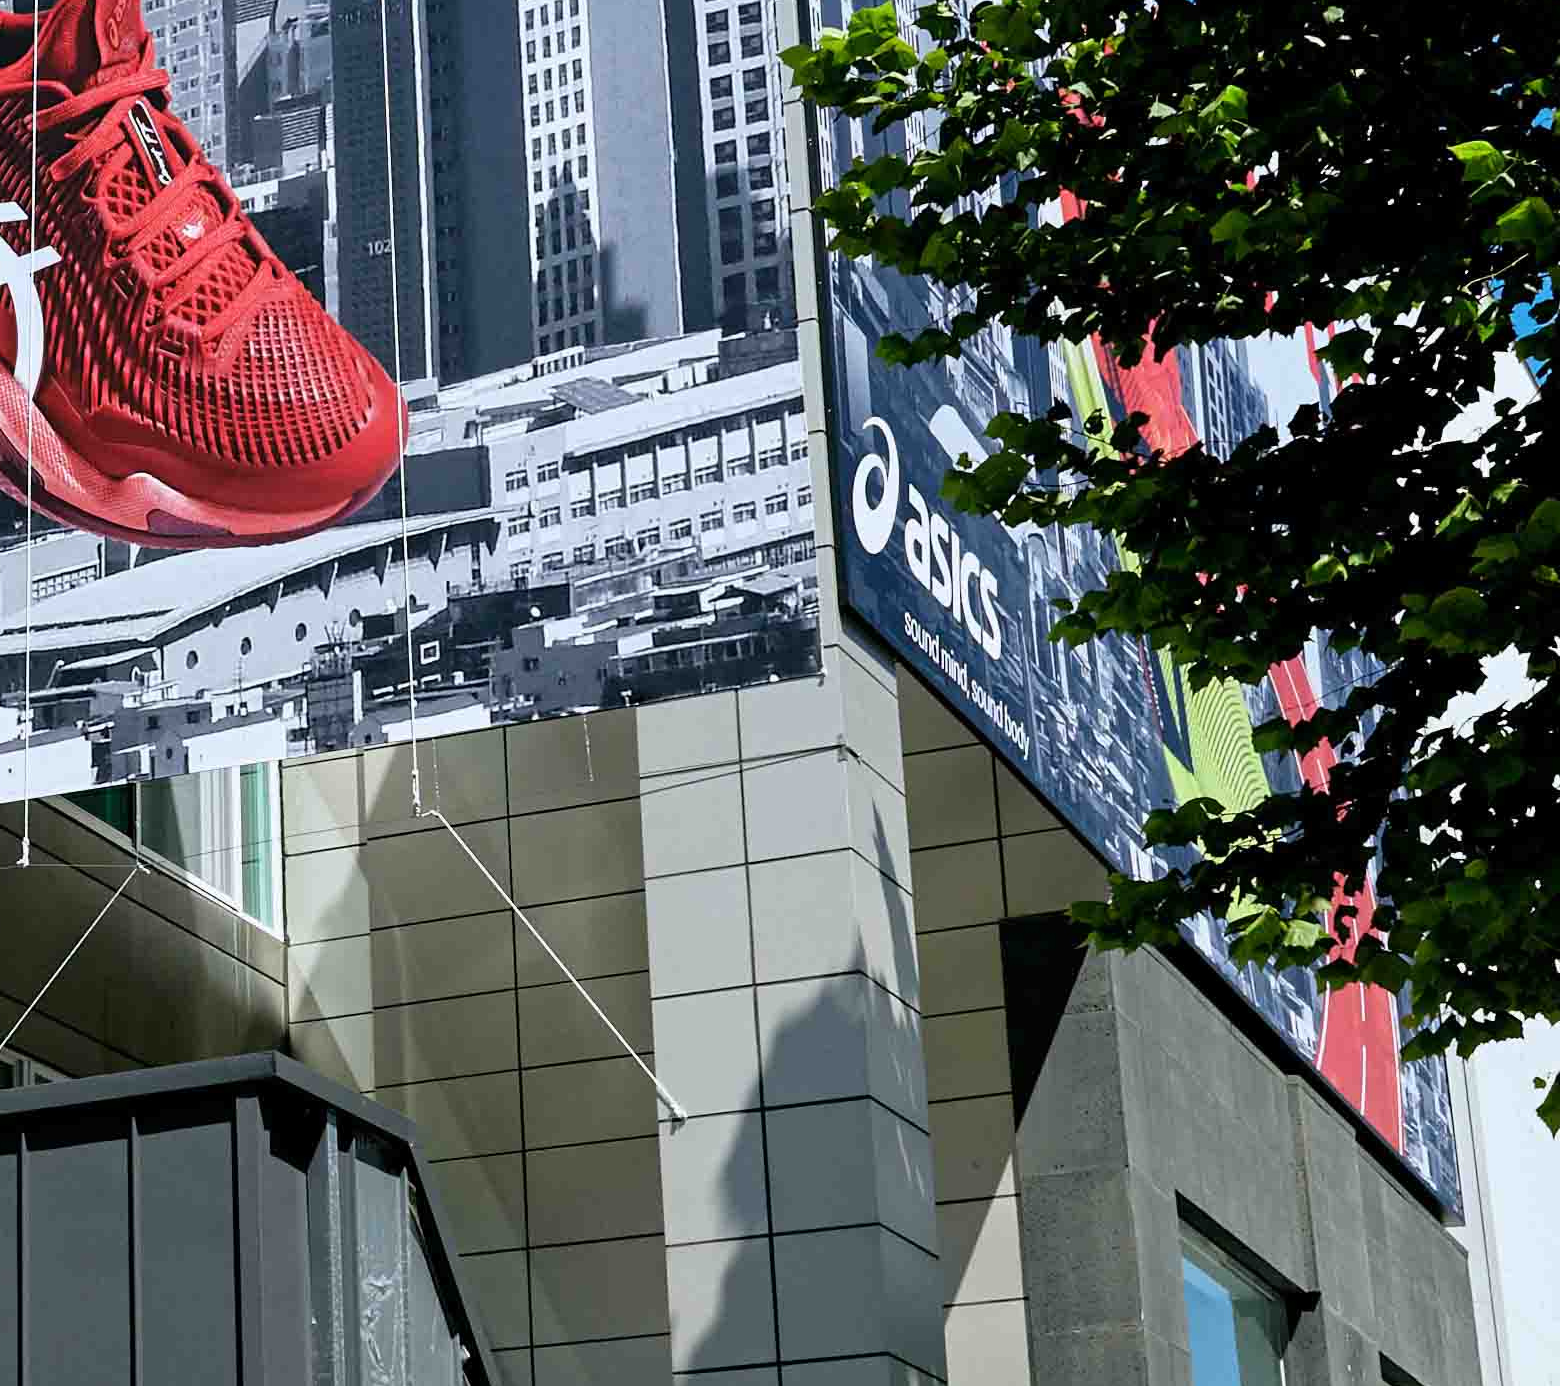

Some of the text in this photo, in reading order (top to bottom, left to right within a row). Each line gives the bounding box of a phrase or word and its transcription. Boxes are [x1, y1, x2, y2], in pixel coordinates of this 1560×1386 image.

[905, 483, 1002, 661] asics
[904, 612, 1030, 761] sound mind, sound body
